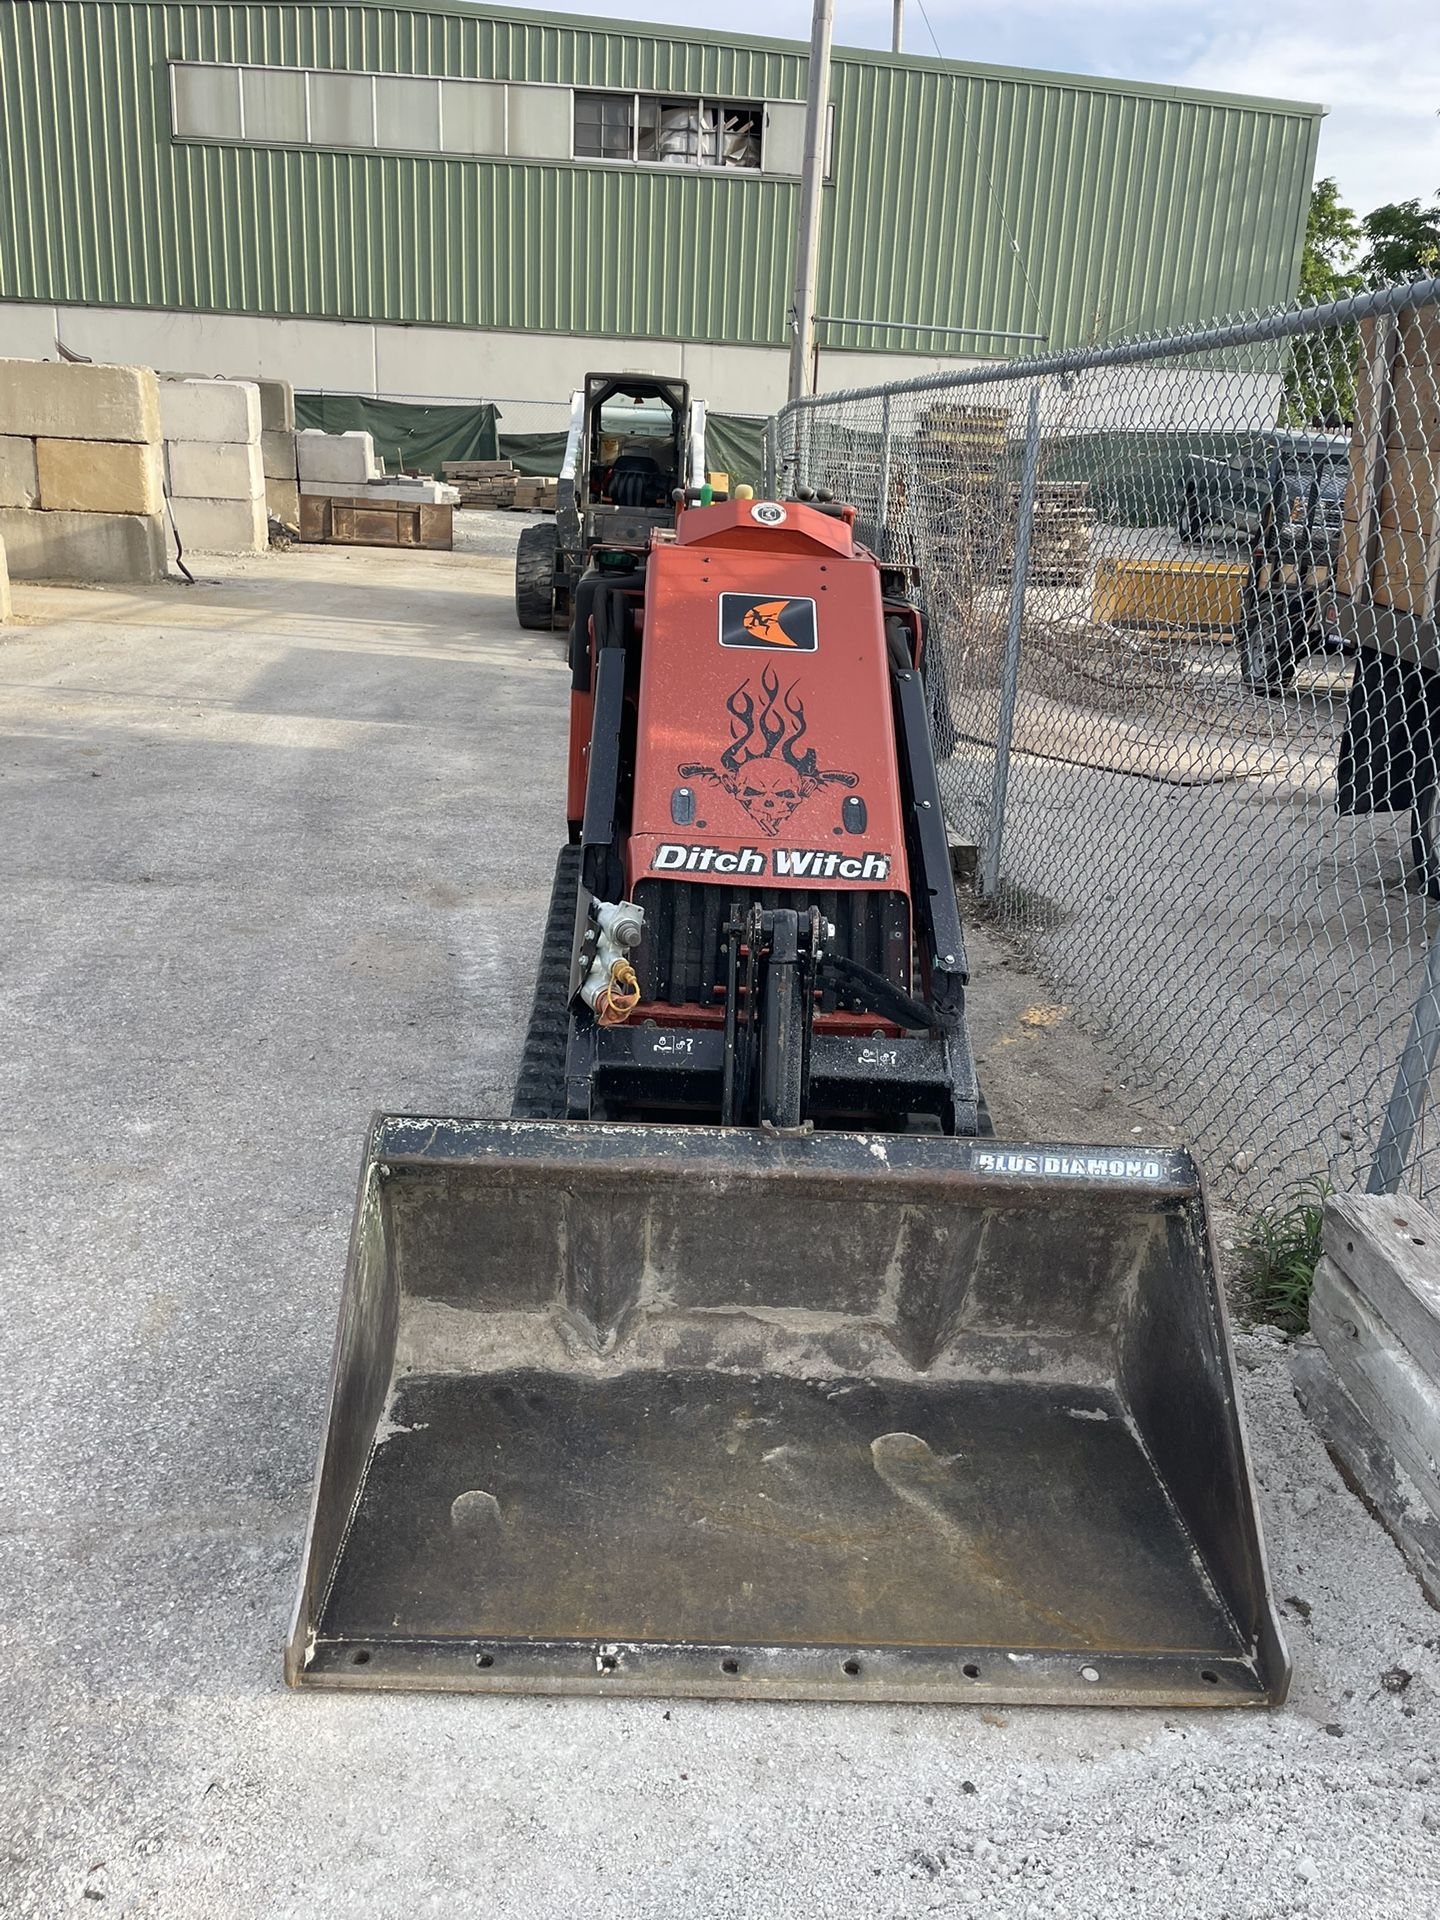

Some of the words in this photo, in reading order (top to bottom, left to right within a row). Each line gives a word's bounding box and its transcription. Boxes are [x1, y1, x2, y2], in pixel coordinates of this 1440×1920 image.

[654, 845, 764, 873] Ditch
[776, 850, 888, 880] Witch
[979, 1154, 1038, 1172] BLUE
[1044, 1157, 1160, 1178] DIAMOND
